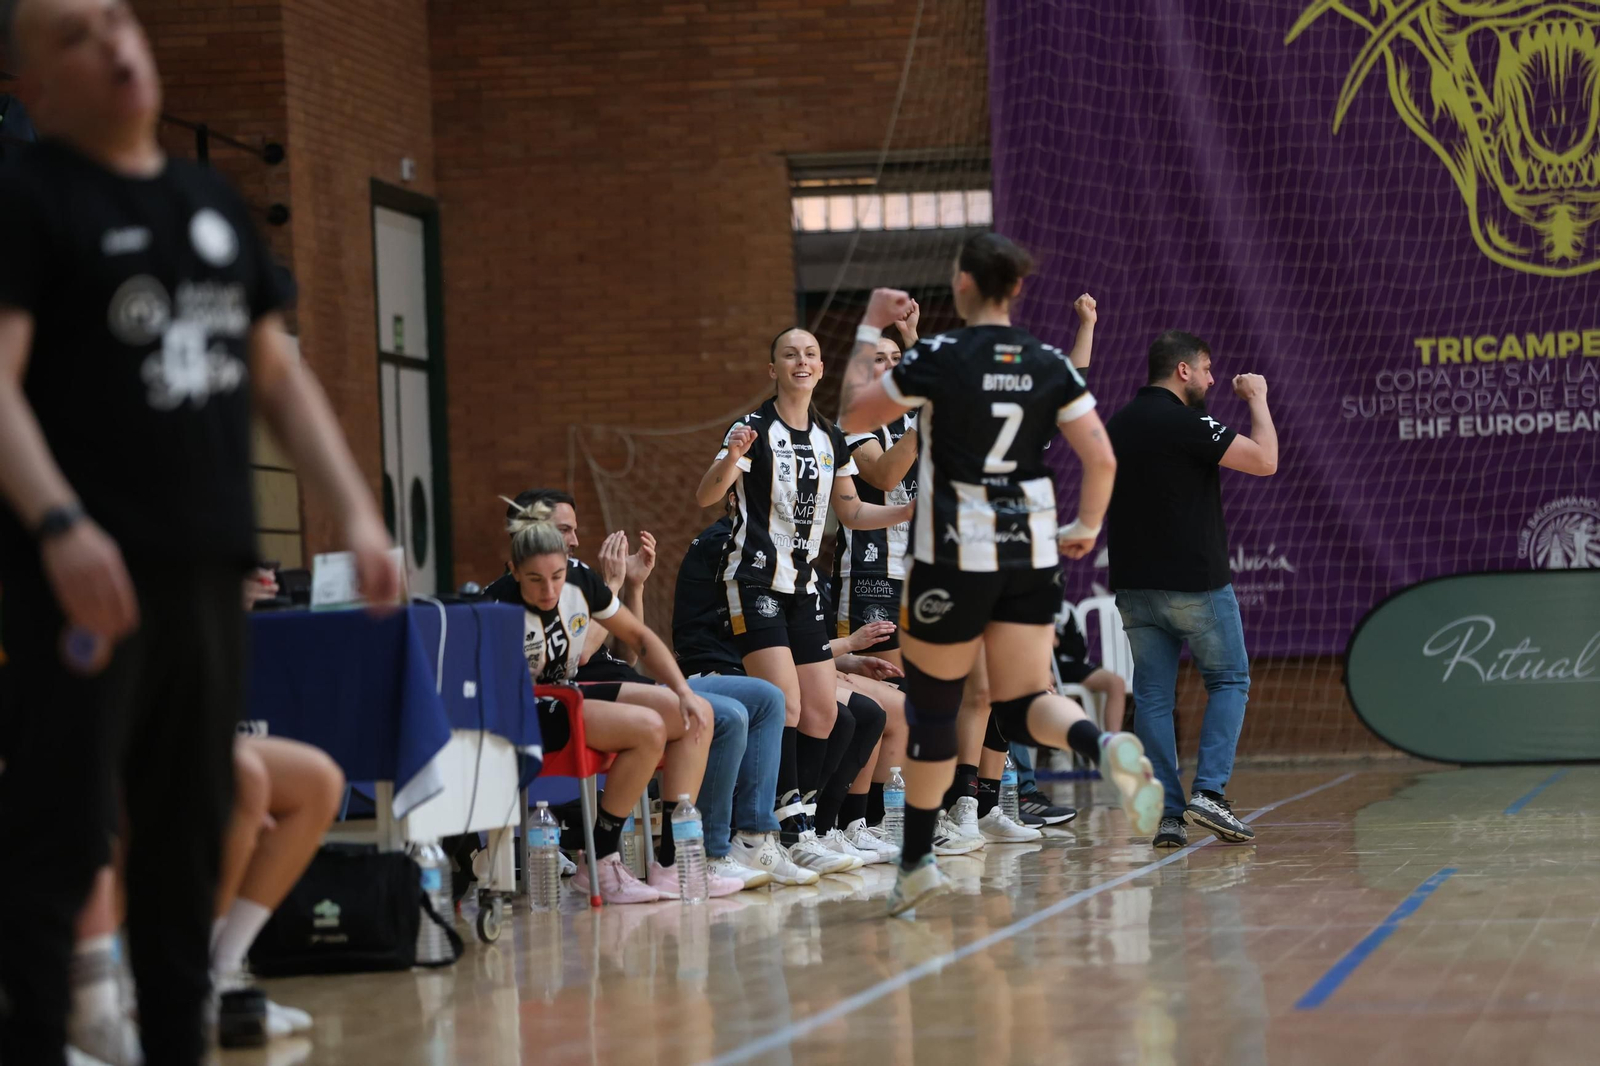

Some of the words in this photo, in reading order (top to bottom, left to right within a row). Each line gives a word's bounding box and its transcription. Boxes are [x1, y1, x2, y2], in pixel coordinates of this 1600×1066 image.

[982, 373, 1033, 391] BITOLO
[1375, 368, 1452, 392] COPA
[1459, 364, 1497, 389] DE
[1342, 390, 1509, 419] SUPERCOPA
[1517, 386, 1555, 410] DE
[1564, 383, 1600, 408] ES
[982, 402, 1024, 474] 2
[1398, 415, 1453, 441] EHF
[796, 455, 819, 480] 73
[778, 489, 828, 505] MÁLAGA
[774, 502, 827, 519] COMPITE
[854, 586, 894, 595] COMPITE
[857, 578, 890, 588] MÁLAGA
[1422, 614, 1600, 684] Ritual
